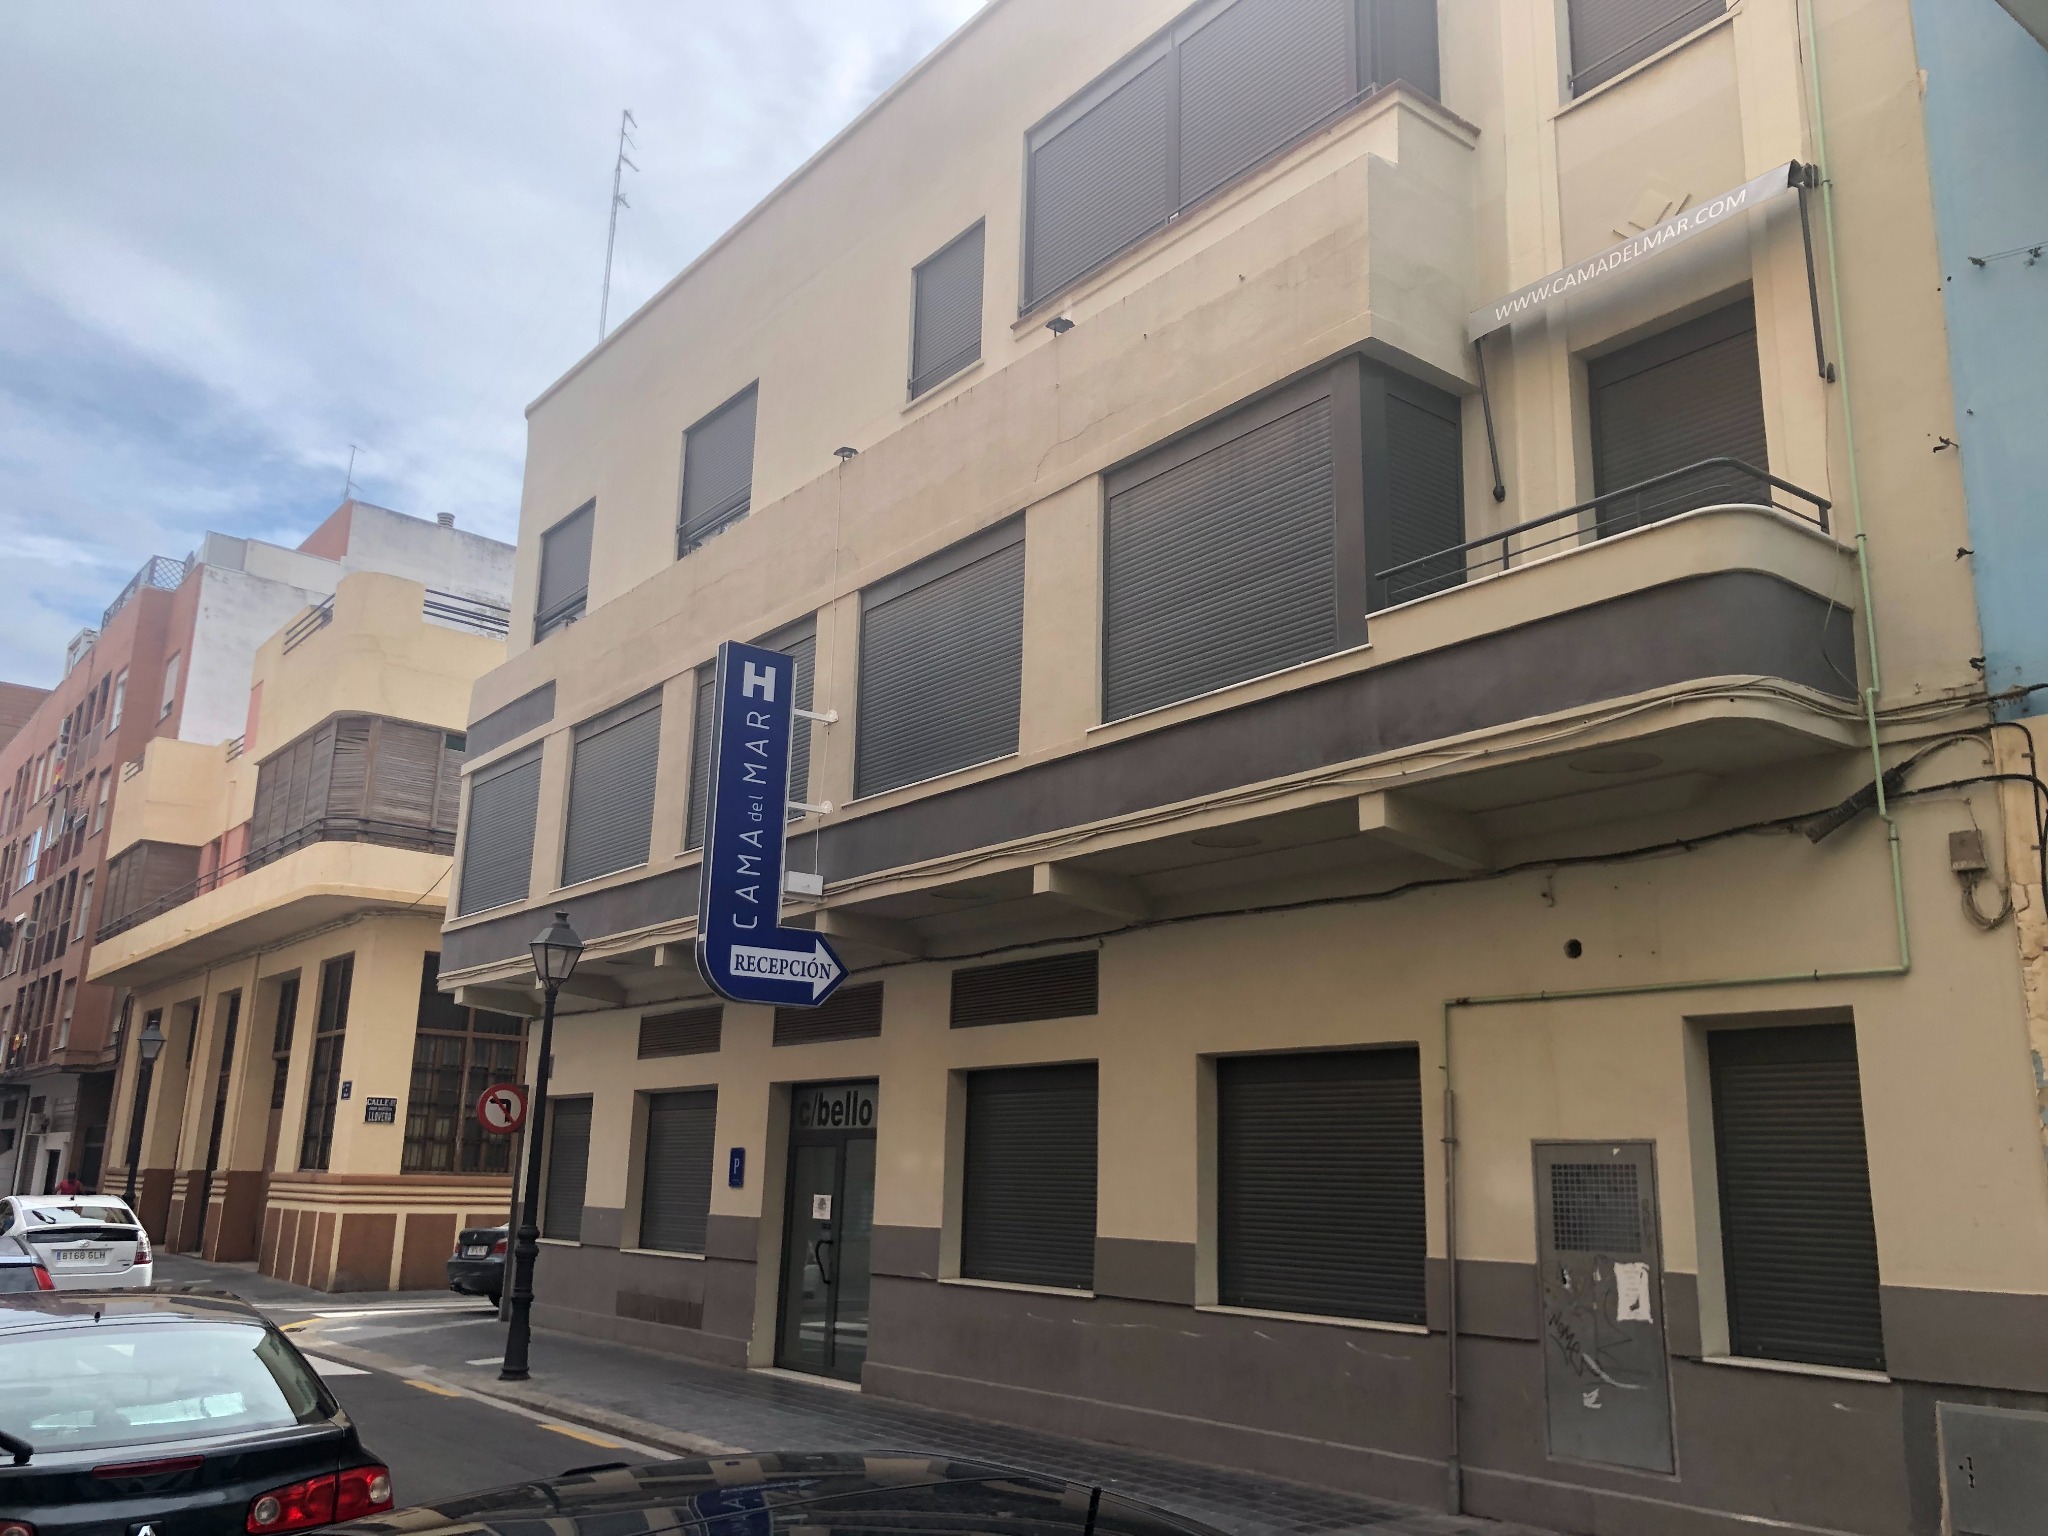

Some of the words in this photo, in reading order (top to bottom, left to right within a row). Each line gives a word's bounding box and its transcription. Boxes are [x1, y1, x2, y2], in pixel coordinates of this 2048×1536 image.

[1495, 188, 1747, 321] WWW.CAMADELMAR.COM
[742, 660, 777, 702] H
[742, 709, 771, 785] MAR
[747, 794, 764, 823] del
[732, 829, 764, 930] CAMA
[734, 952, 833, 980] RECEPCIÓN
